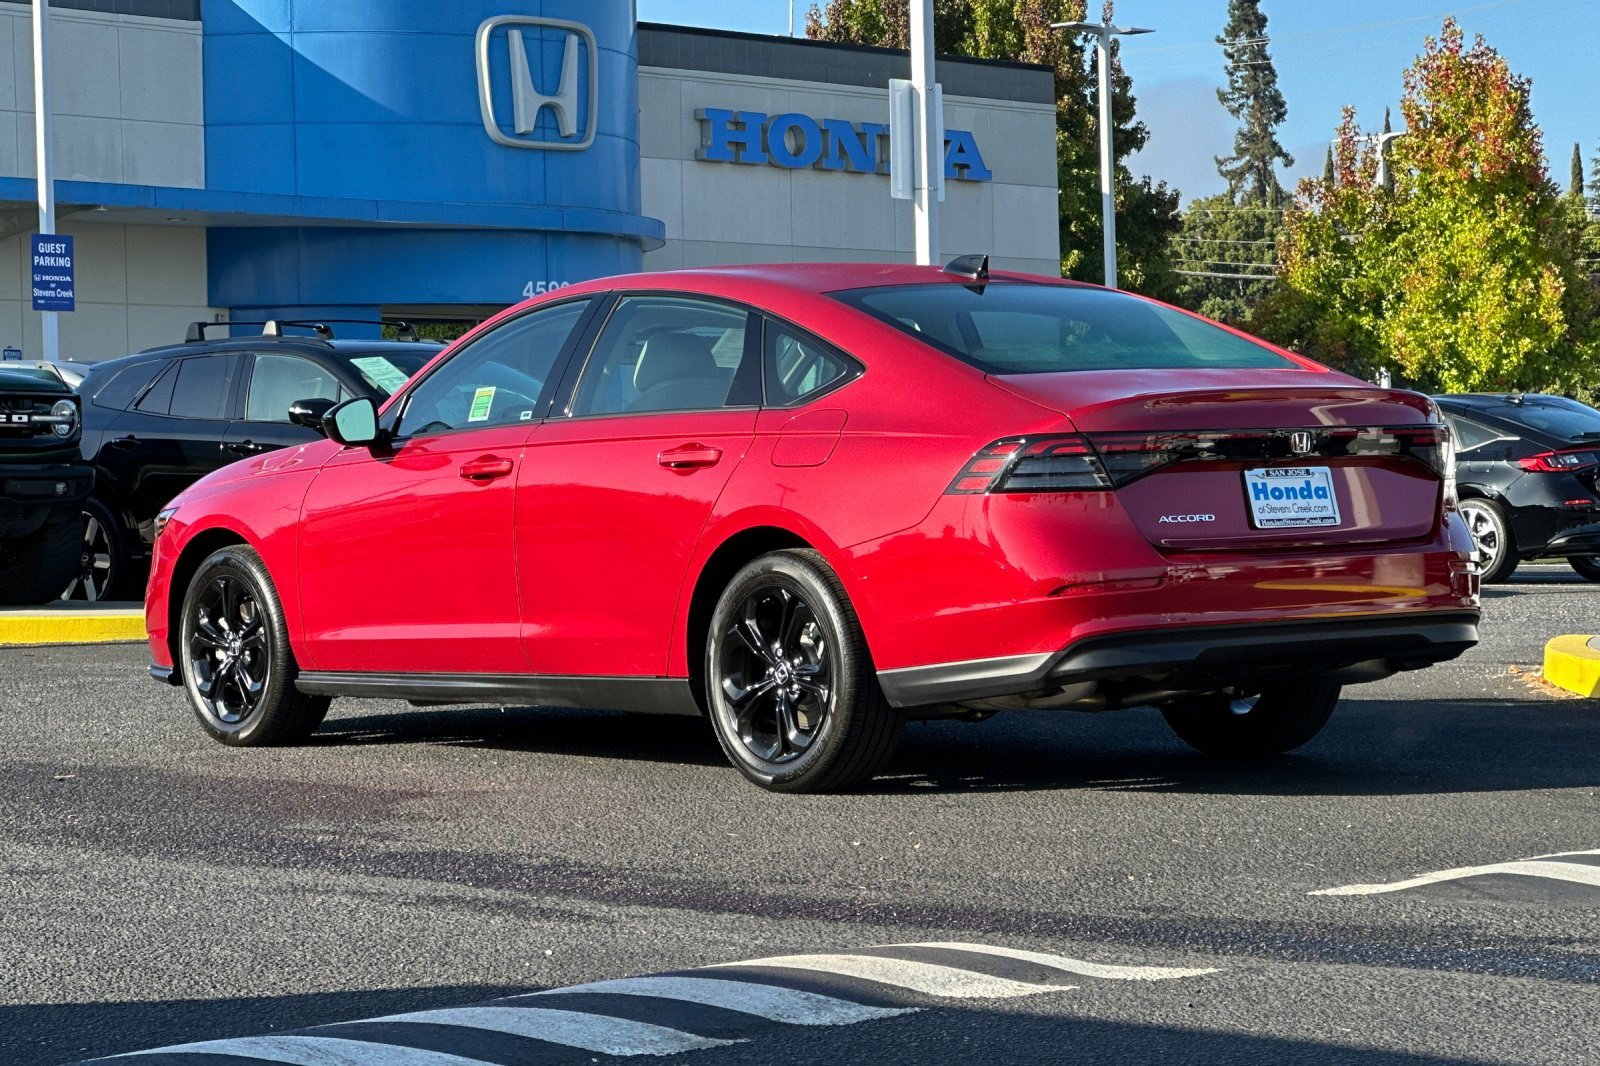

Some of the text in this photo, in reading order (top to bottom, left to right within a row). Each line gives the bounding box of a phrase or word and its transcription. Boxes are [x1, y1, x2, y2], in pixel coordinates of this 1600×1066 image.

[695, 107, 992, 182] HONA
[38, 242, 66, 254] GUEST
[34, 255, 71, 267] PARKING
[33, 287, 74, 298] Stevens Creek
[1269, 468, 1307, 477] SAN JOSE
[1251, 480, 1329, 501] Honda
[1159, 513, 1216, 524] ACCORD
